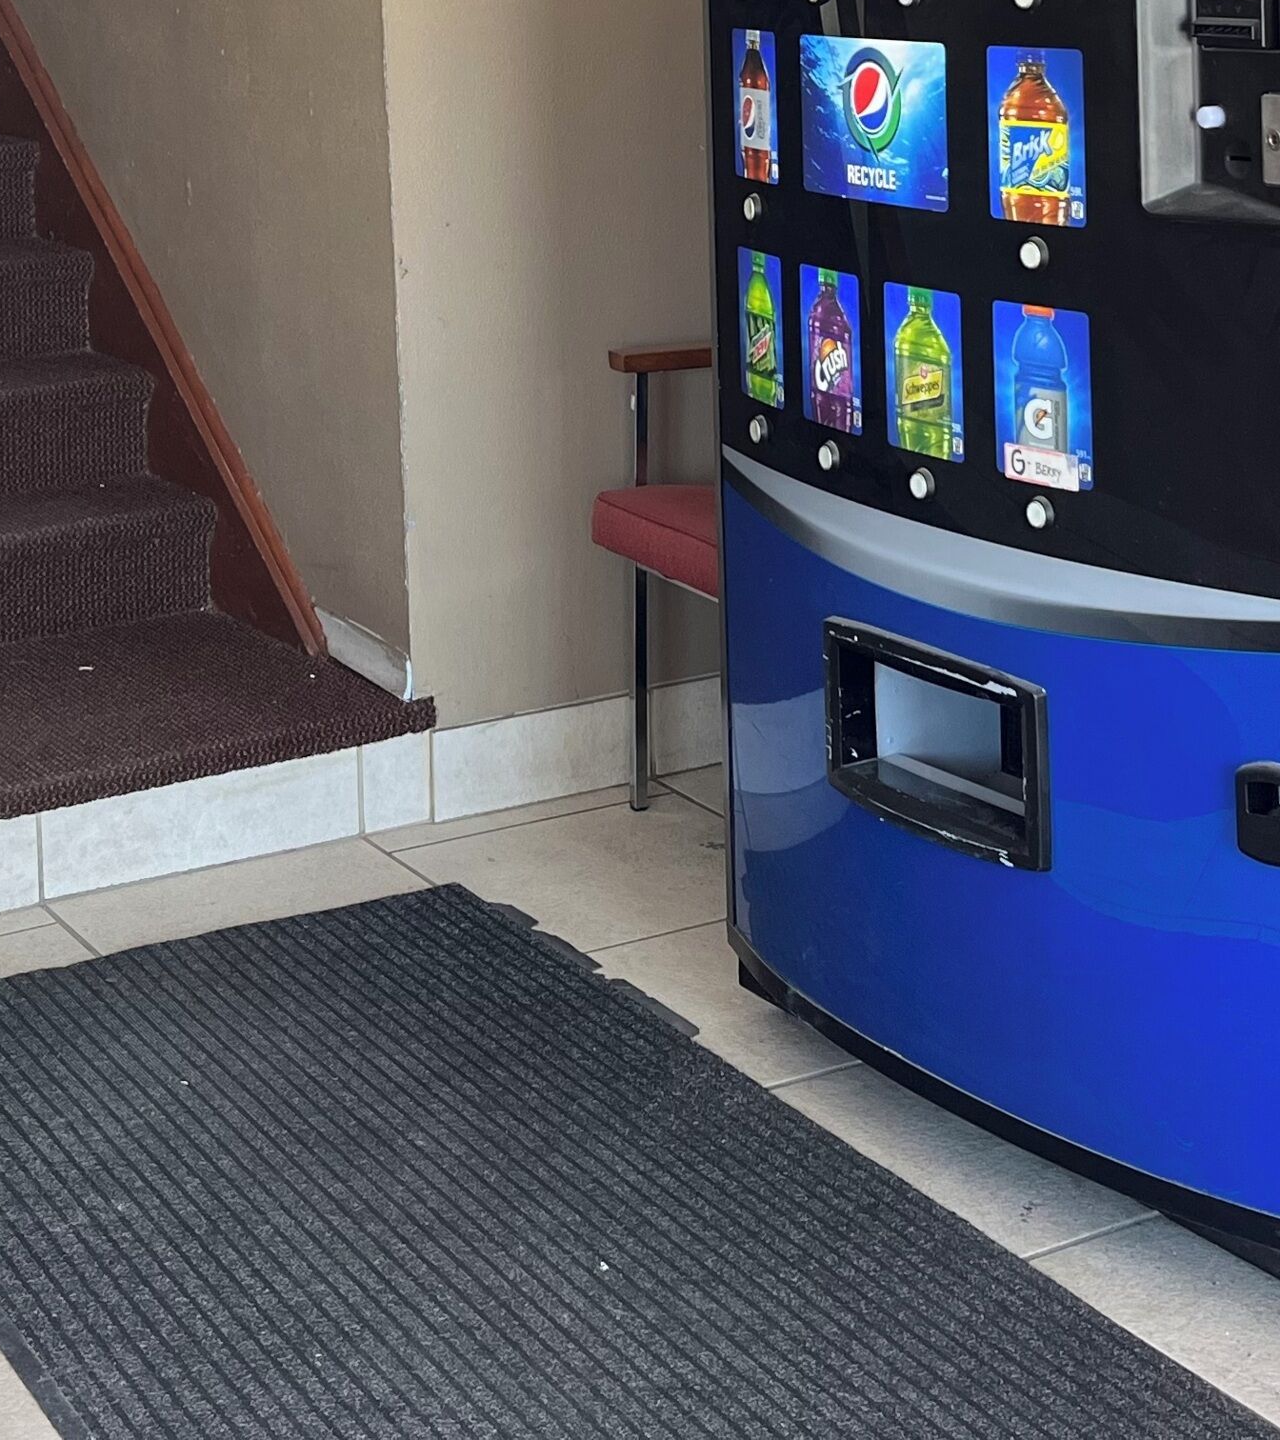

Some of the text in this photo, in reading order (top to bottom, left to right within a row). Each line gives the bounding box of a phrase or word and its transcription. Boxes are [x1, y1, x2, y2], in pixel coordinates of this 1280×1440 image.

[1012, 129, 1053, 168] Brisk
[847, 164, 897, 190] RECYCLE
[815, 340, 848, 392] Crush
[906, 379, 940, 399] Schweppes
[1024, 398, 1053, 440] G
[1035, 462, 1062, 483] BERRY
